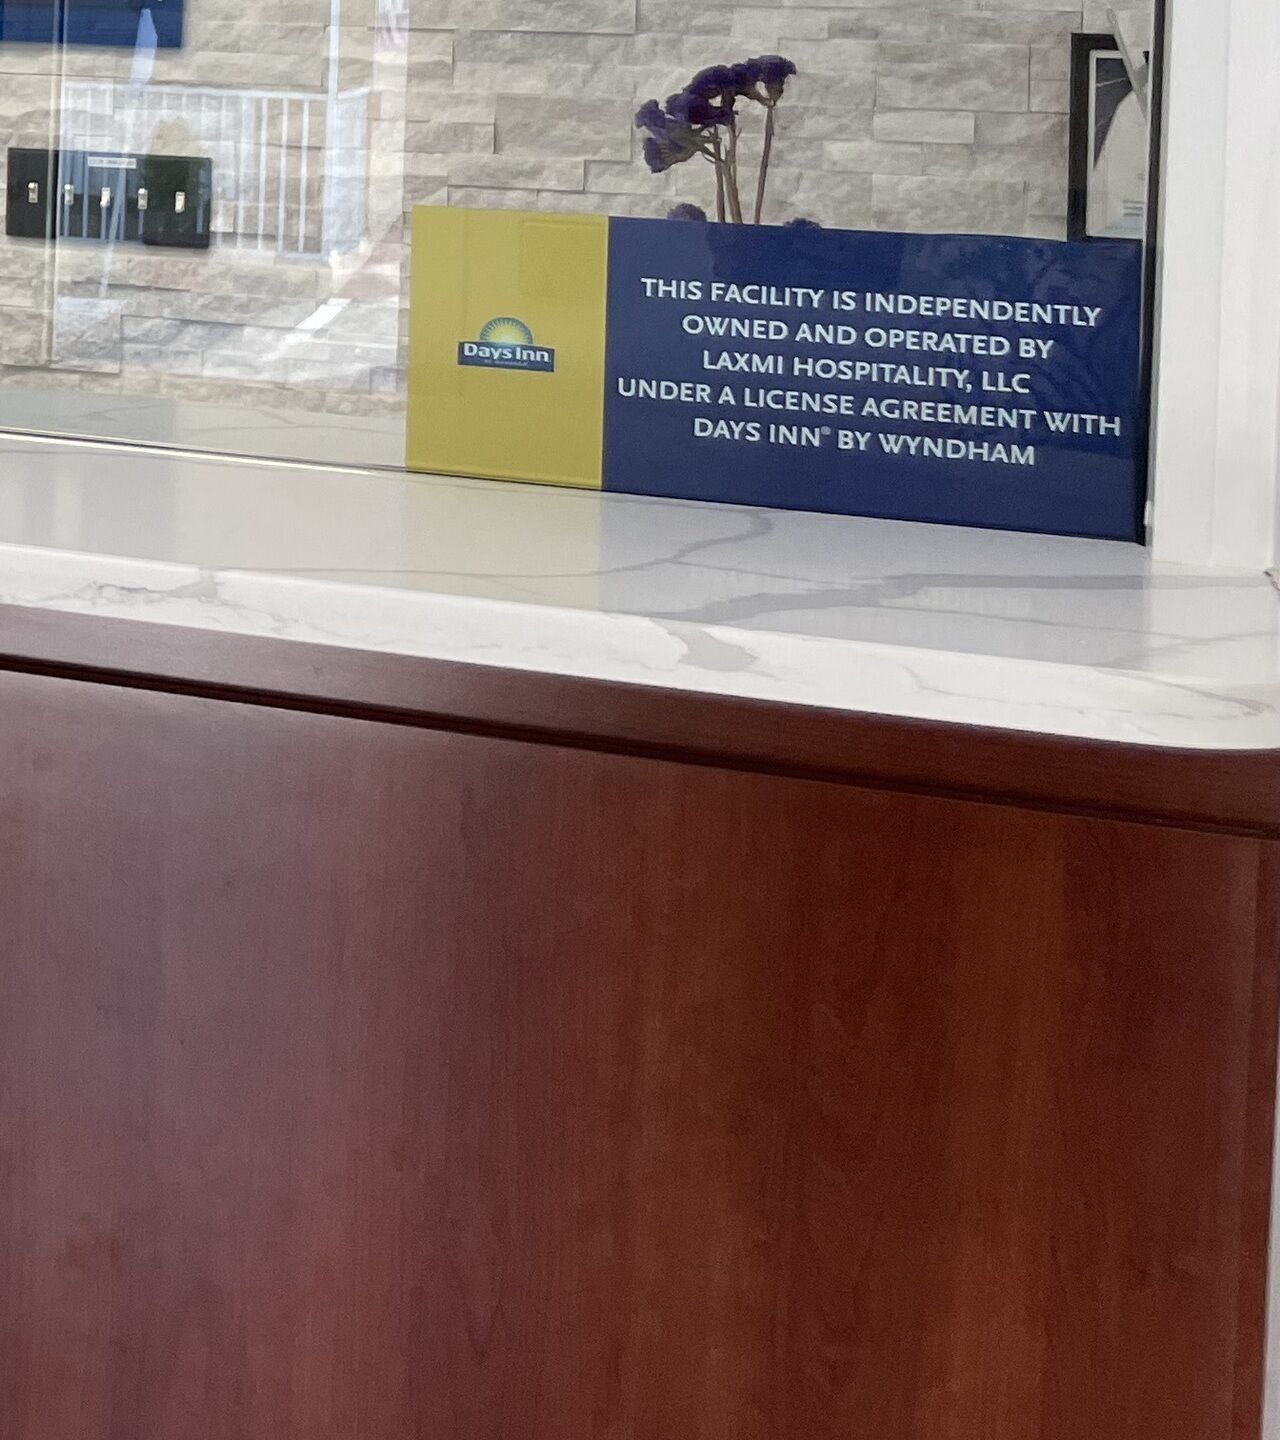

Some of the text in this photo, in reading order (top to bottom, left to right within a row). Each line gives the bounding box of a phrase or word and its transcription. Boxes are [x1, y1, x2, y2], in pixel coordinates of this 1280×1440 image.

[641, 277, 1101, 327] THIS FACILITY IS INDEPENDENTLY
[464, 343, 550, 362] Days Inn
[682, 315, 1054, 359] OWNED AND OPERATED BY
[703, 350, 1030, 394] LAXMI HOSPITALITY, LLC
[617, 377, 1121, 437] UNDER A LICENSE AGREEMENT WITH
[694, 417, 761, 442] DAYS
[837, 430, 871, 450] BY
[878, 432, 1036, 466] WYNDHAM
